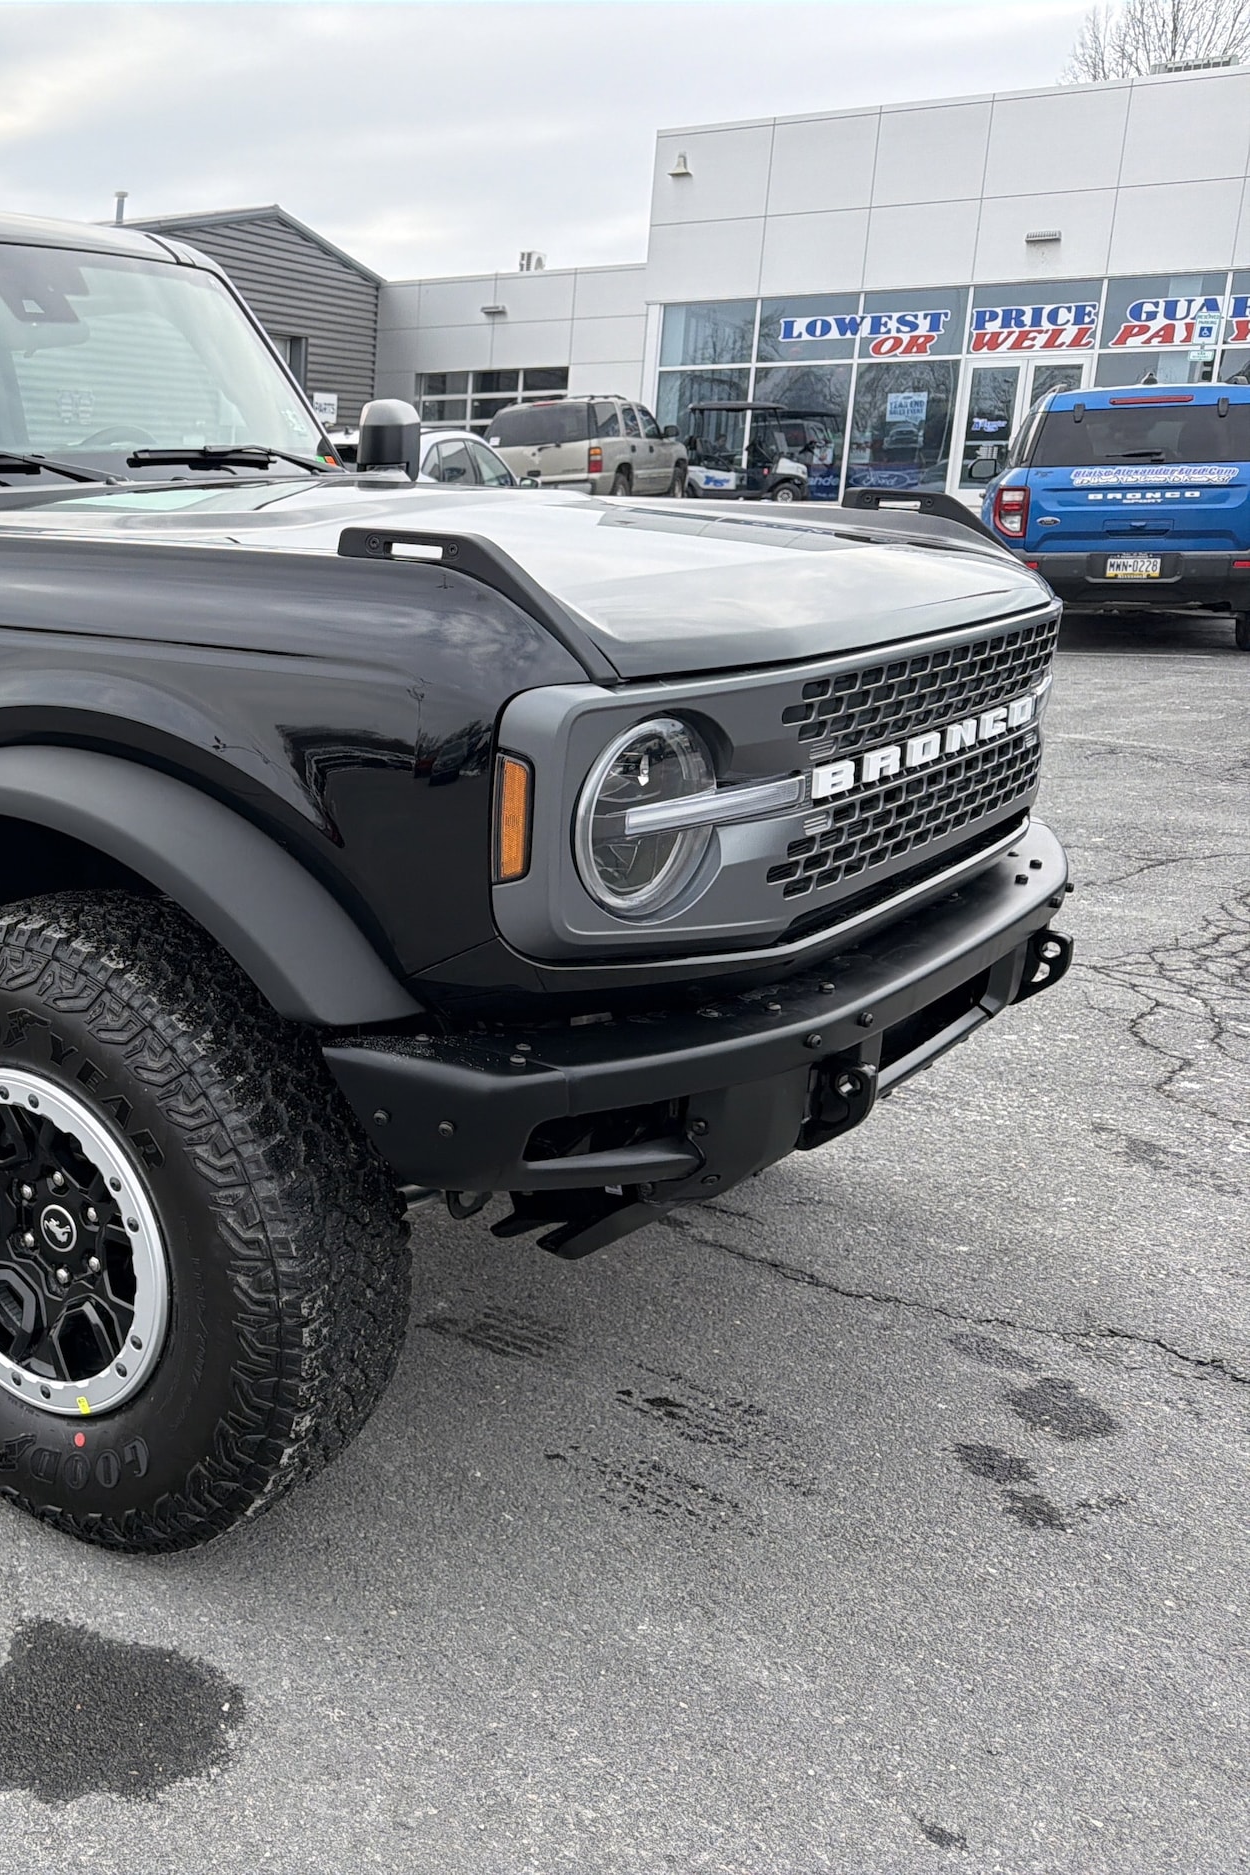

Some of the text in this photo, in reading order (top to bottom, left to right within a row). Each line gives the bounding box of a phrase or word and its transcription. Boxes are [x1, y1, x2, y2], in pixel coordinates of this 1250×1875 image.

[781, 311, 950, 341] LOWEST
[972, 303, 1098, 331] PRICE
[870, 334, 936, 356] OR
[971, 326, 1094, 352] WE'LL
[1087, 491, 1201, 500] BRONCO
[811, 695, 1034, 799] BRONCO
